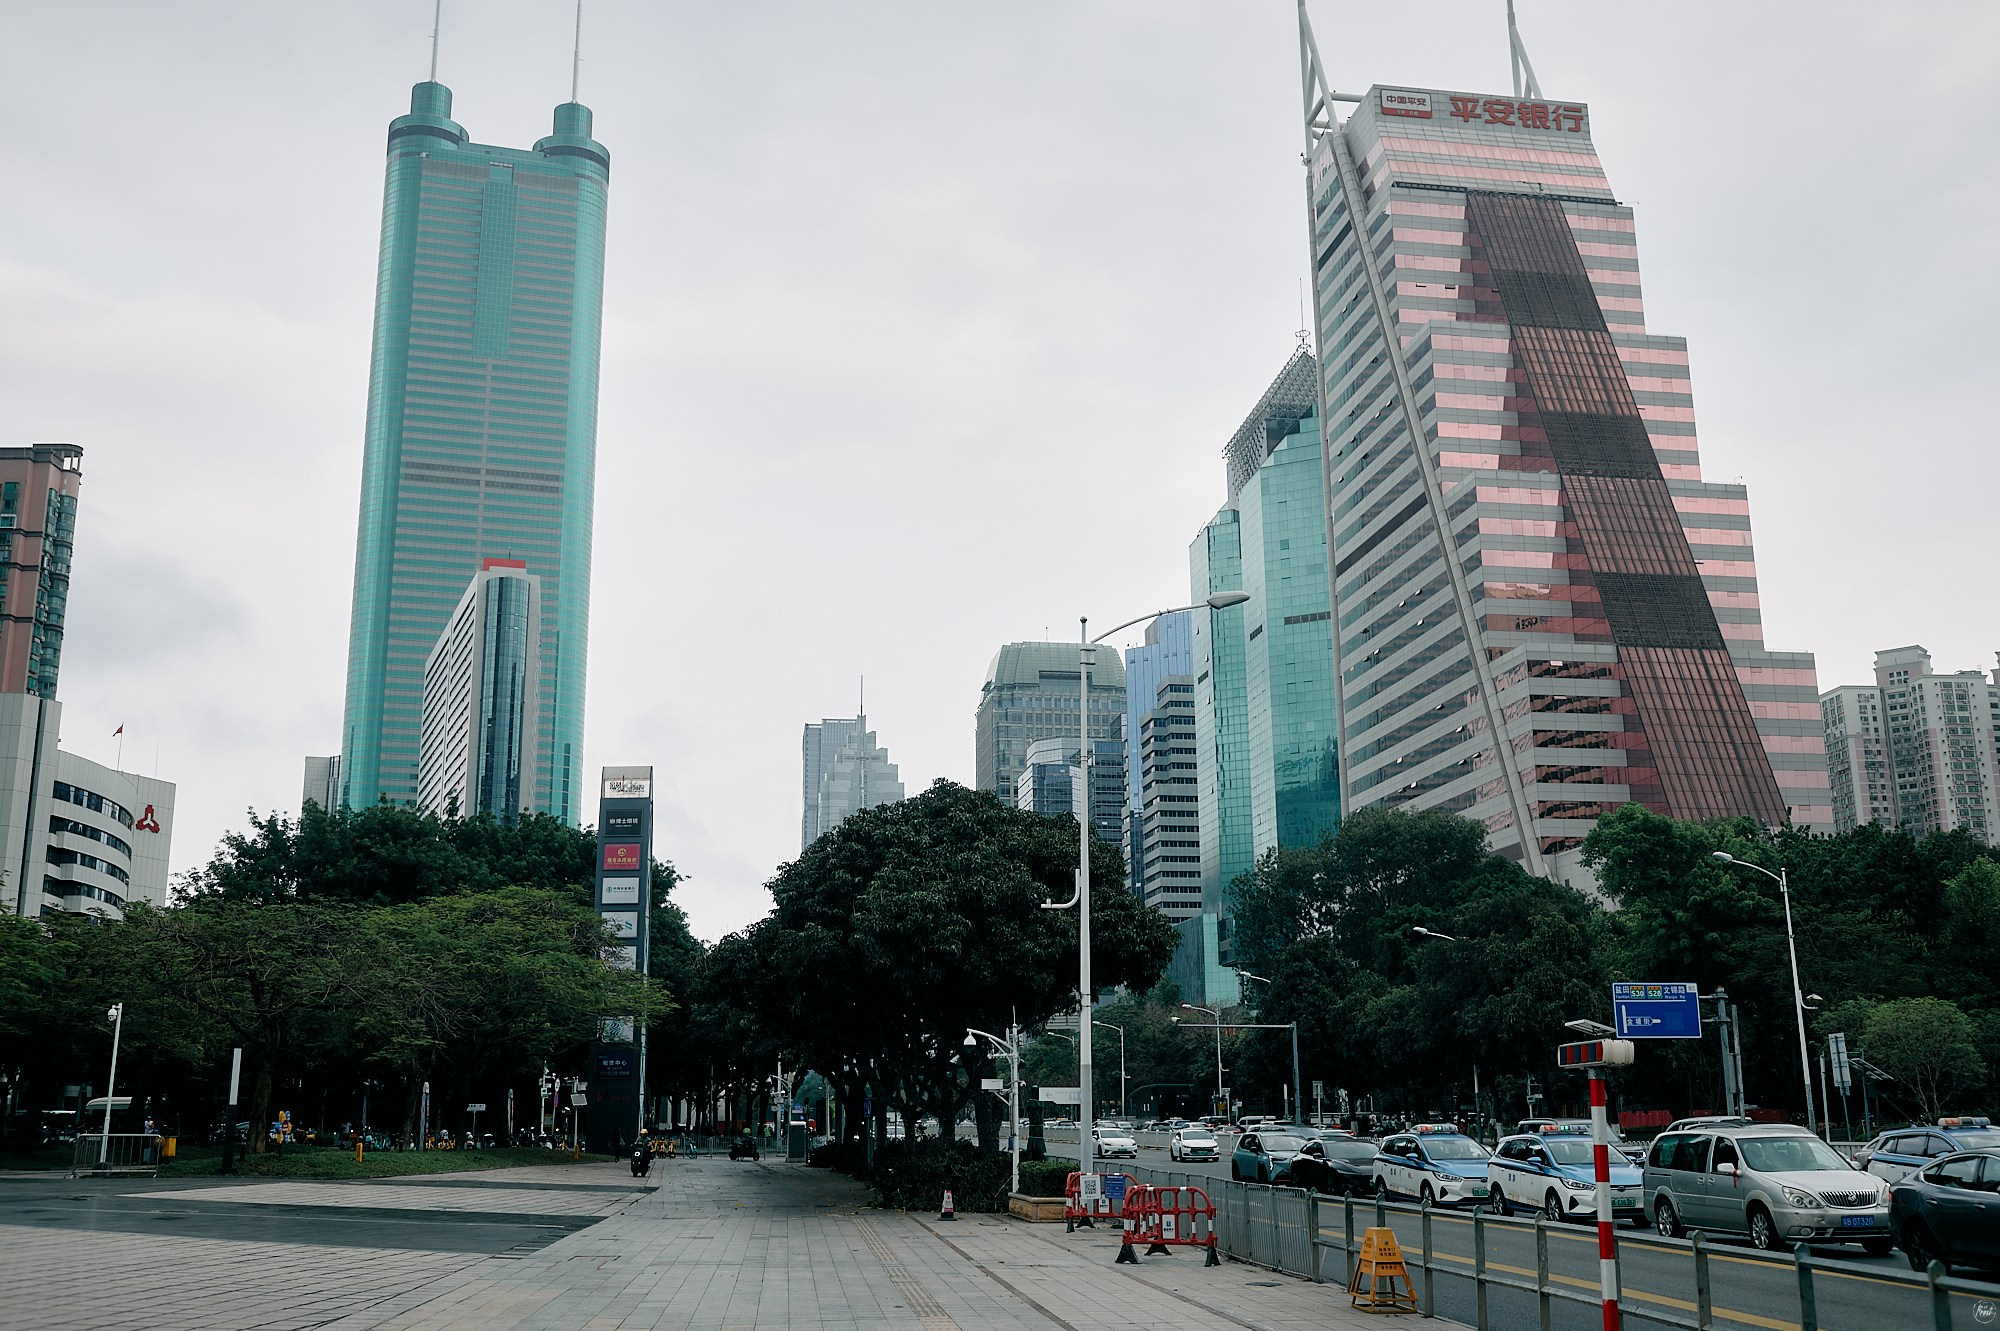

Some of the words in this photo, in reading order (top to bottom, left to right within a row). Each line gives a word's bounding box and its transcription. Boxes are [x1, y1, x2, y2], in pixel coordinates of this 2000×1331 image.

[1386, 94, 1427, 107] 中国平安
[1449, 96, 1584, 133] 平安银行
[1615, 985, 1630, 994] 盐田
[1663, 985, 1686, 995] 文锦路
